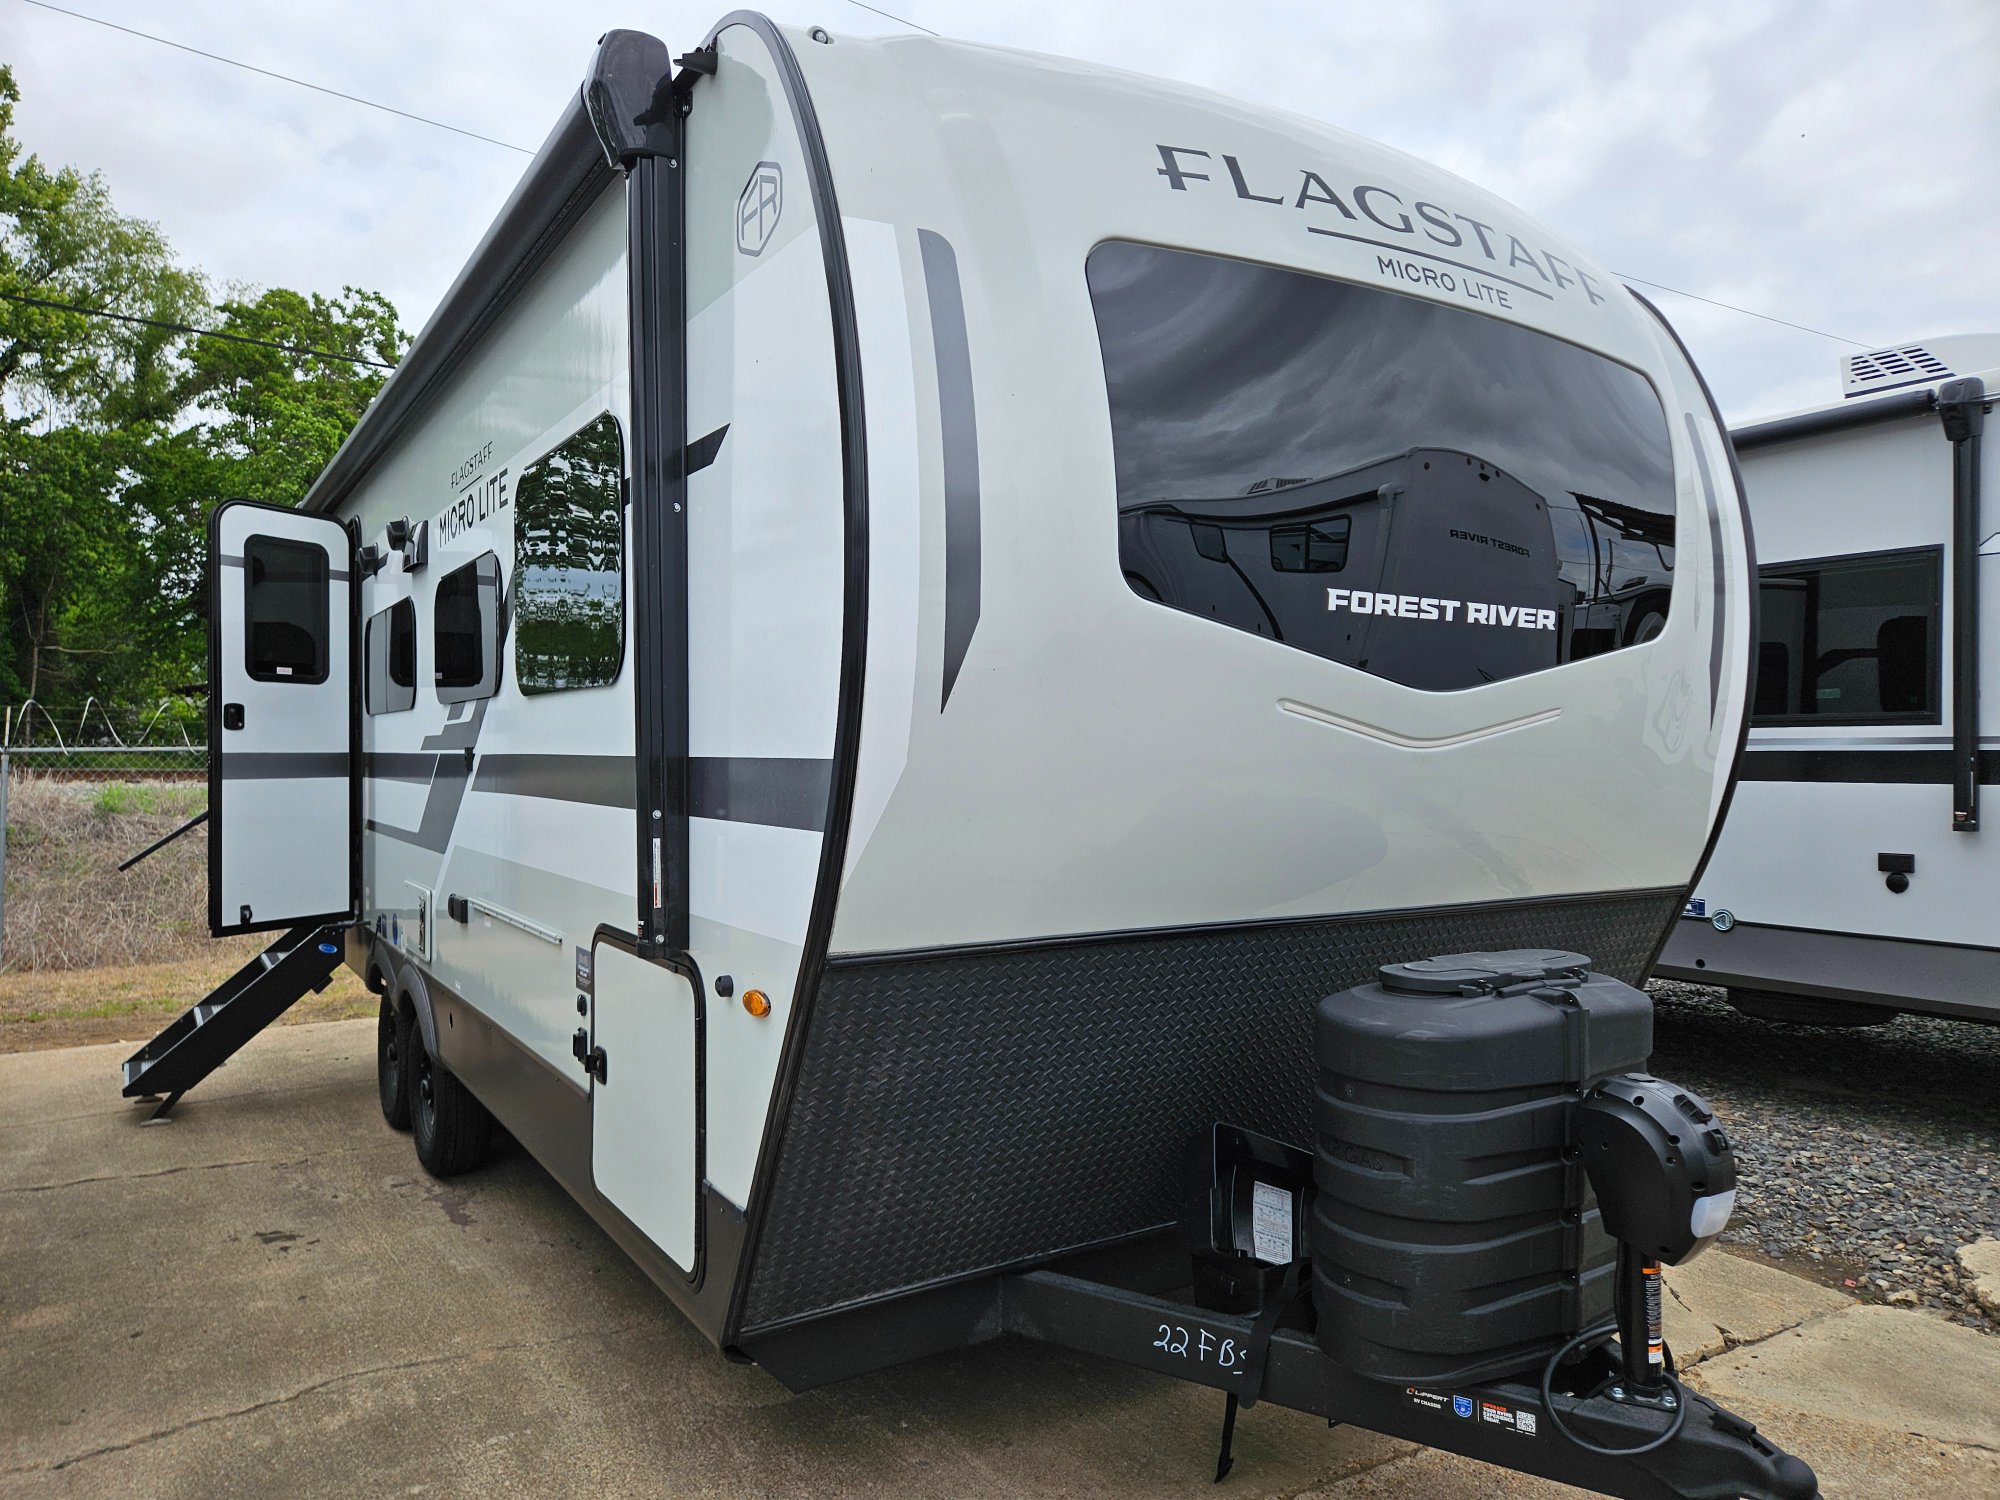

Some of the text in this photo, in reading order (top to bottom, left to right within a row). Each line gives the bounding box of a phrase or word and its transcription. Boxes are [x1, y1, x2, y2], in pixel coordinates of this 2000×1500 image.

[1156, 144, 1606, 307] FLAGSTAFF
[1377, 255, 1513, 309] MICRO LITE
[450, 441, 493, 489] FLAGSTAFF
[439, 467, 509, 548] MICRO LITE
[1326, 587, 1556, 631] FOREST RIVER
